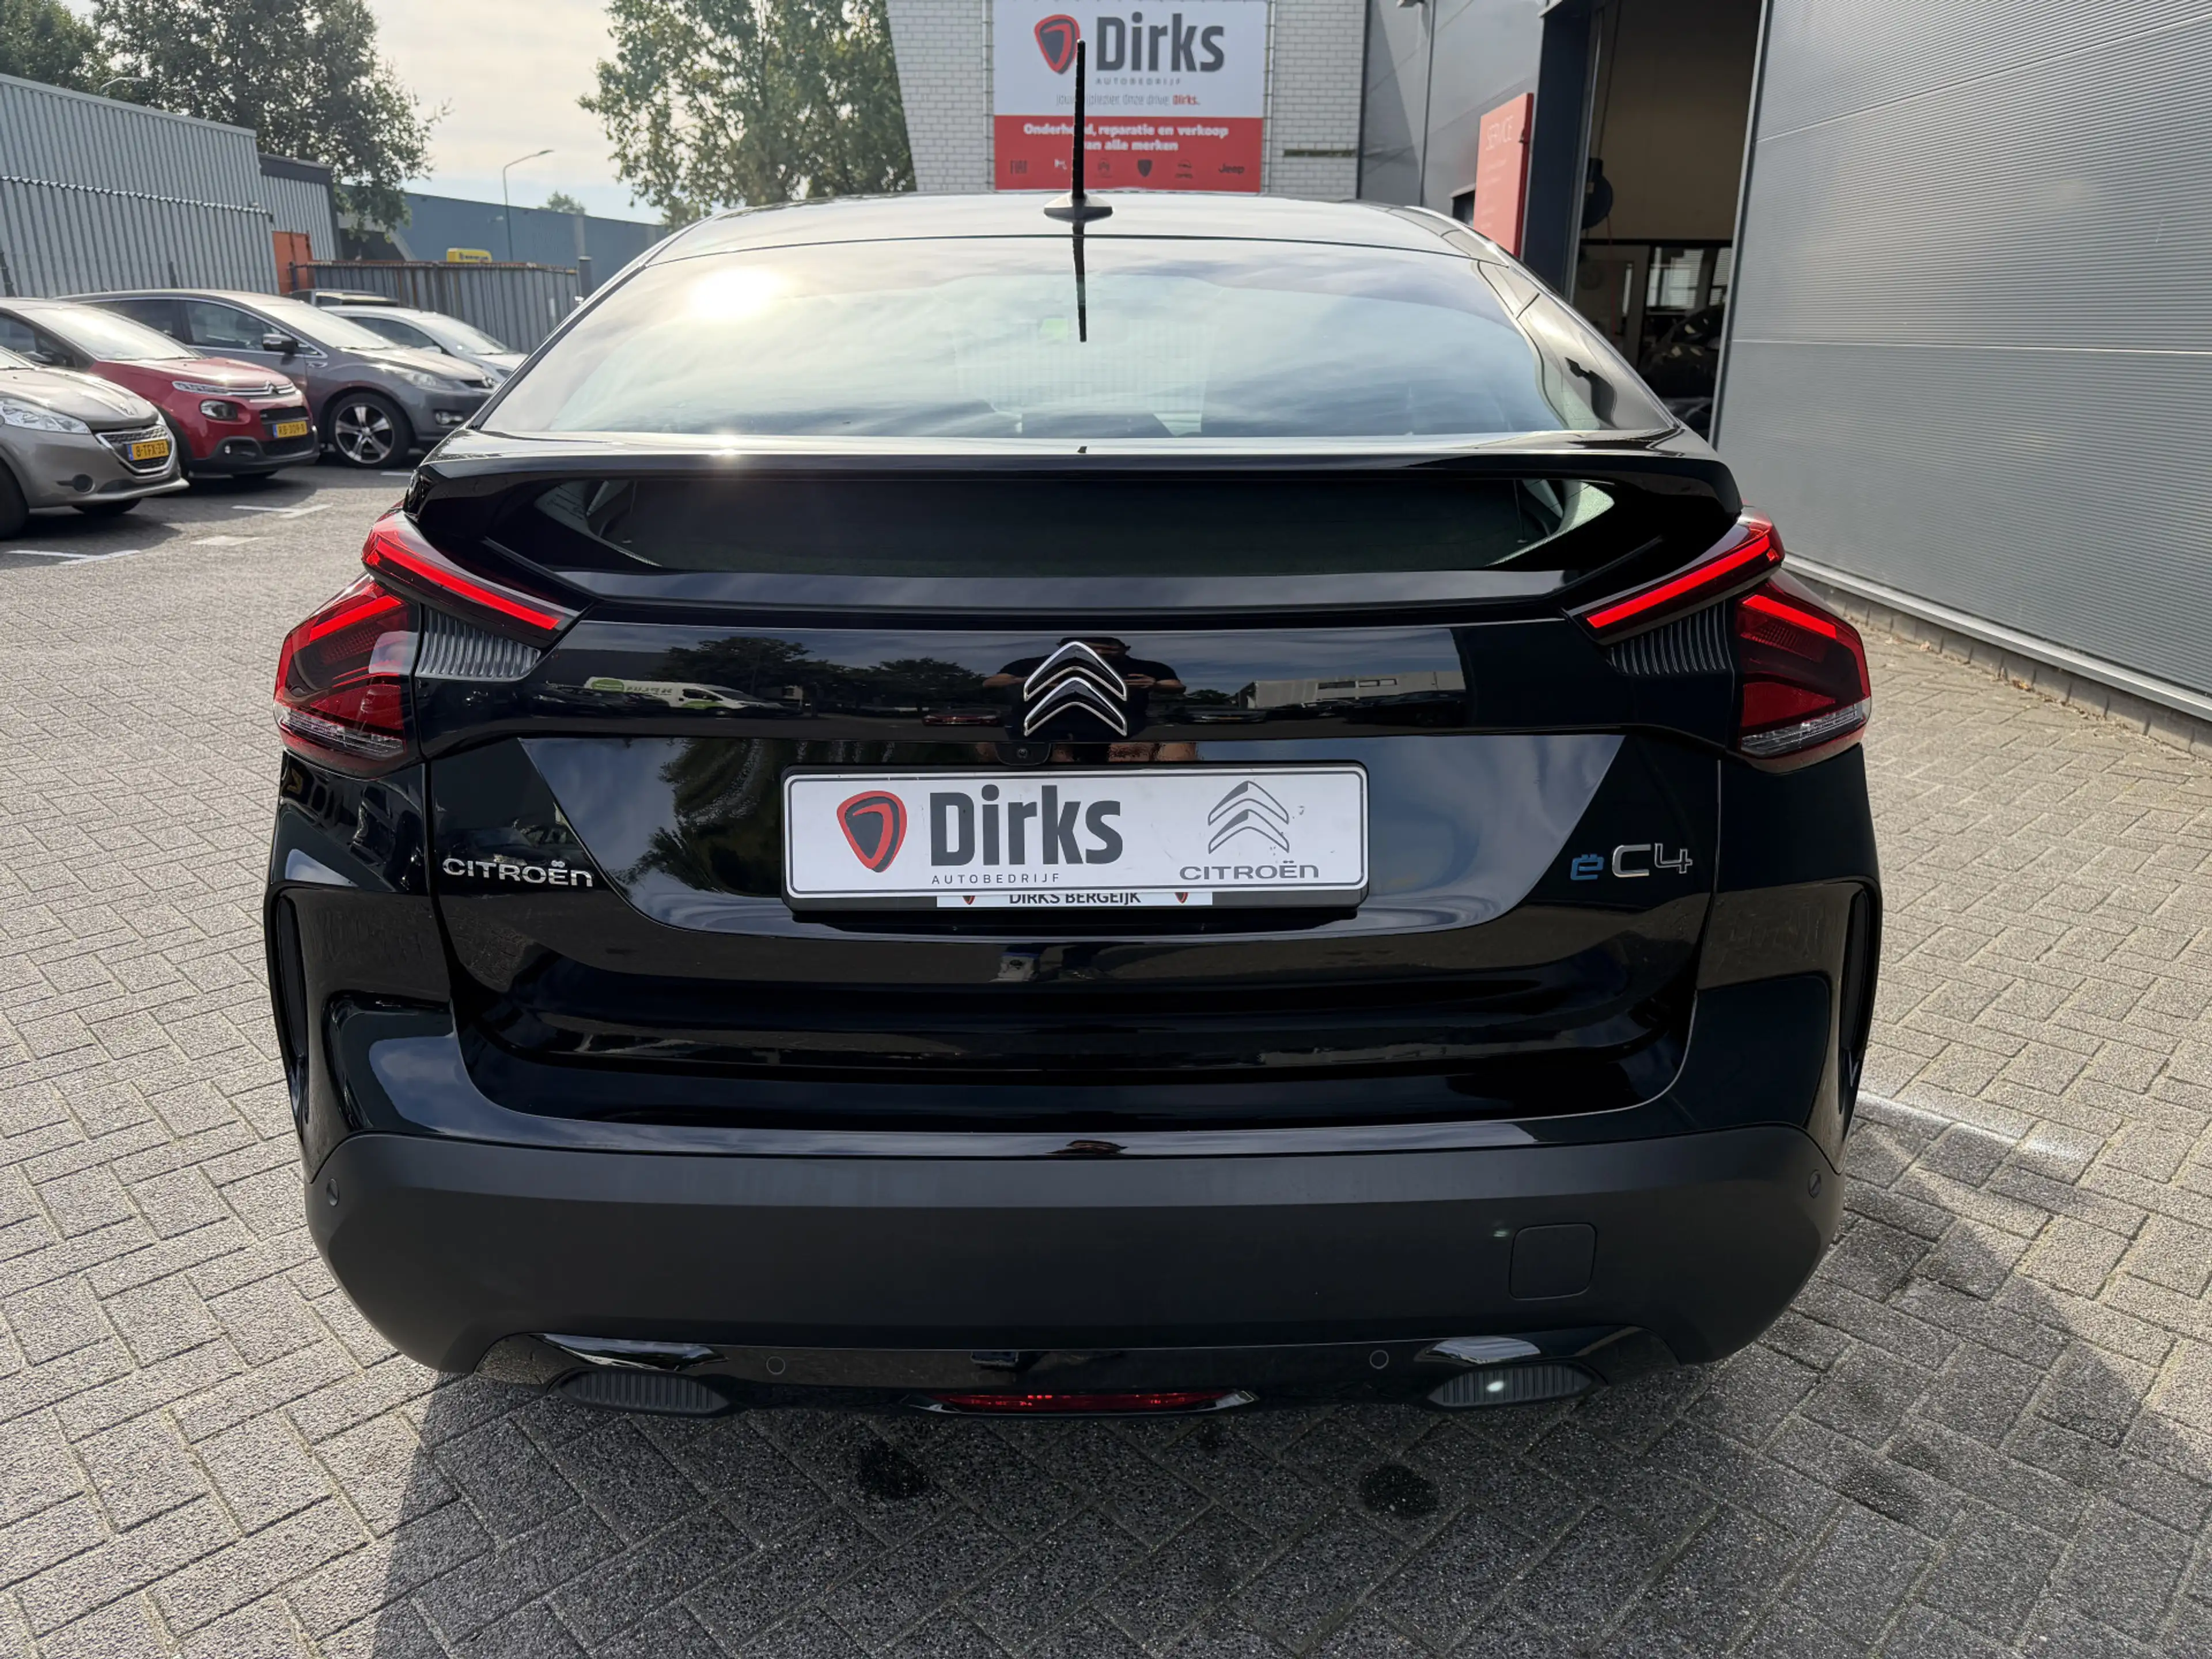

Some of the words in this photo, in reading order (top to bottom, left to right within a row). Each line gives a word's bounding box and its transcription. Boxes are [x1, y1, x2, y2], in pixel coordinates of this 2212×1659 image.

[1097, 11, 1225, 72] Dirks
[1099, 124, 1154, 138] reparatie
[1157, 127, 1174, 135] en
[1177, 124, 1229, 139] verkoop
[1104, 139, 1128, 150] alle
[1131, 139, 1179, 150] merken
[930, 783, 1123, 866] Dirks
[931, 873, 1059, 885] AUTOBEDRIJF
[1009, 893, 1060, 904] DIRKS
[1065, 892, 1141, 905] BERGEIJK
